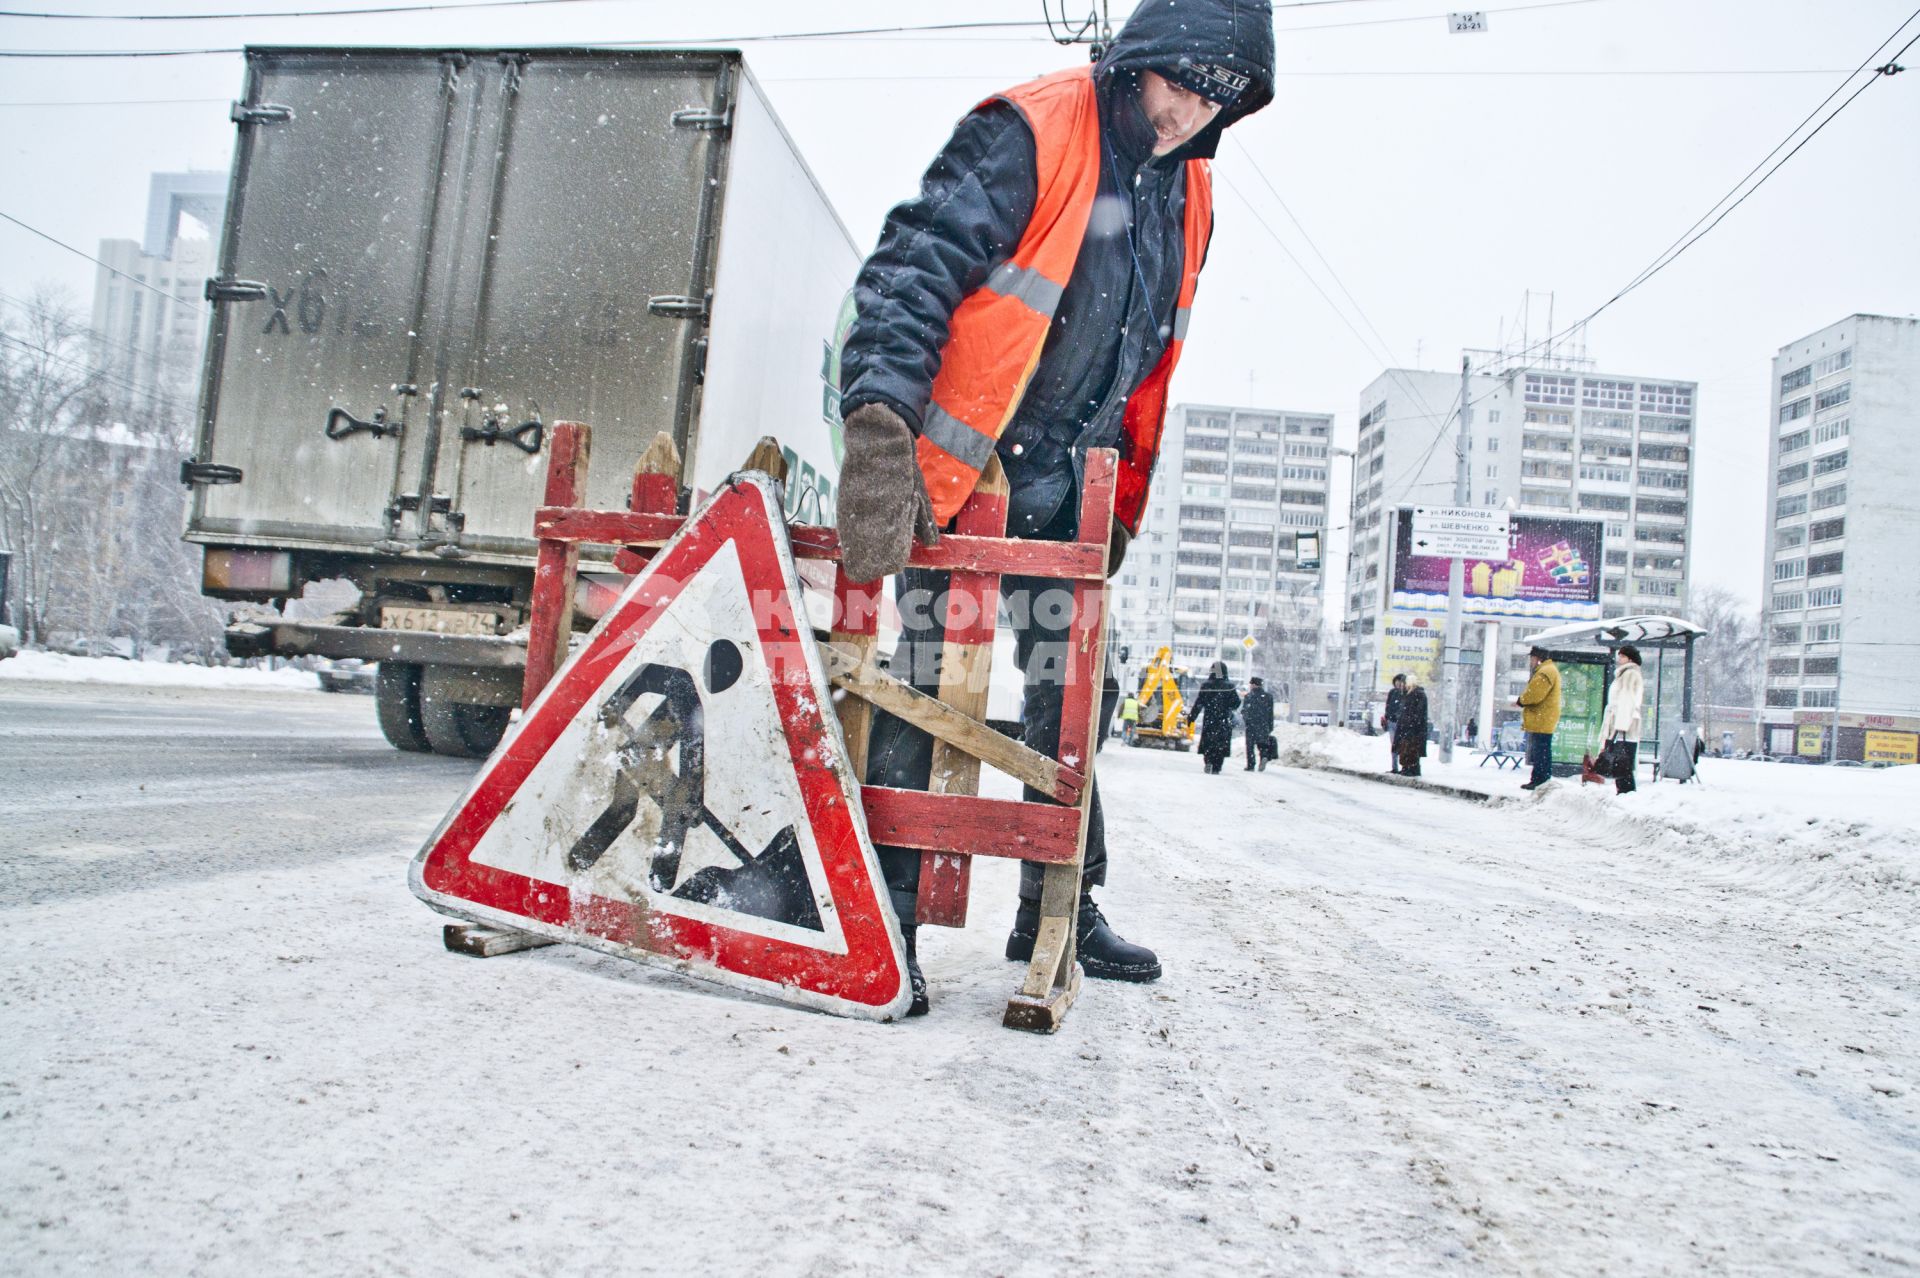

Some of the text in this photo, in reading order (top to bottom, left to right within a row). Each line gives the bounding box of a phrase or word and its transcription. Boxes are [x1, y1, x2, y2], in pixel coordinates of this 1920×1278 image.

[1462, 14, 1473, 22] 12
[1456, 22, 1481, 30] 23-21
[1440, 508, 1493, 519] НИКОНОВА
[1440, 521, 1490, 532] ШЕВЧЕНКО
[1385, 627, 1441, 639] ПЕРЕКРЕСТОК
